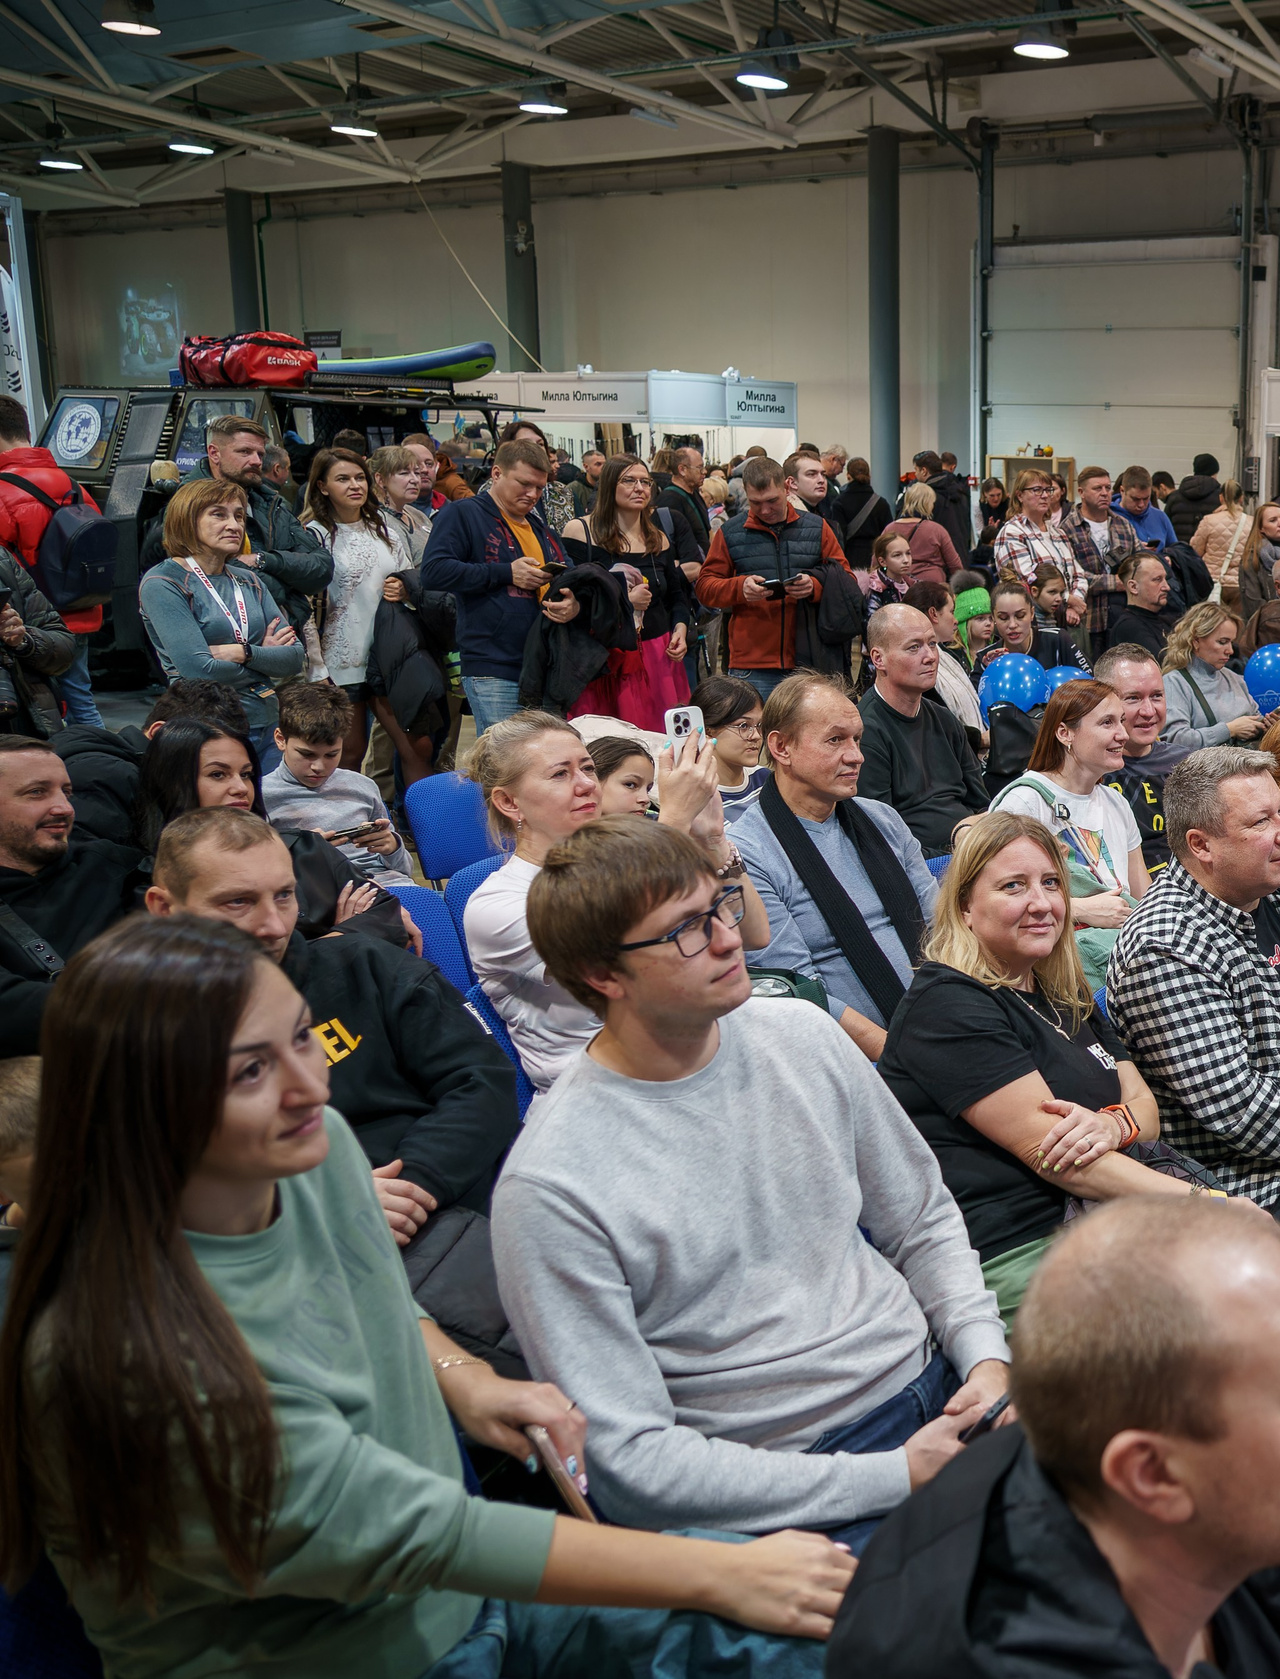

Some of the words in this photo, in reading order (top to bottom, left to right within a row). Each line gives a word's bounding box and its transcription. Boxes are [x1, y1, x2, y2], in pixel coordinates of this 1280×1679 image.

[541, 390, 570, 401] Милла
[572, 390, 619, 402] Юлтыгина
[745, 390, 777, 402] Милла
[737, 401, 786, 414] Юлтыгина
